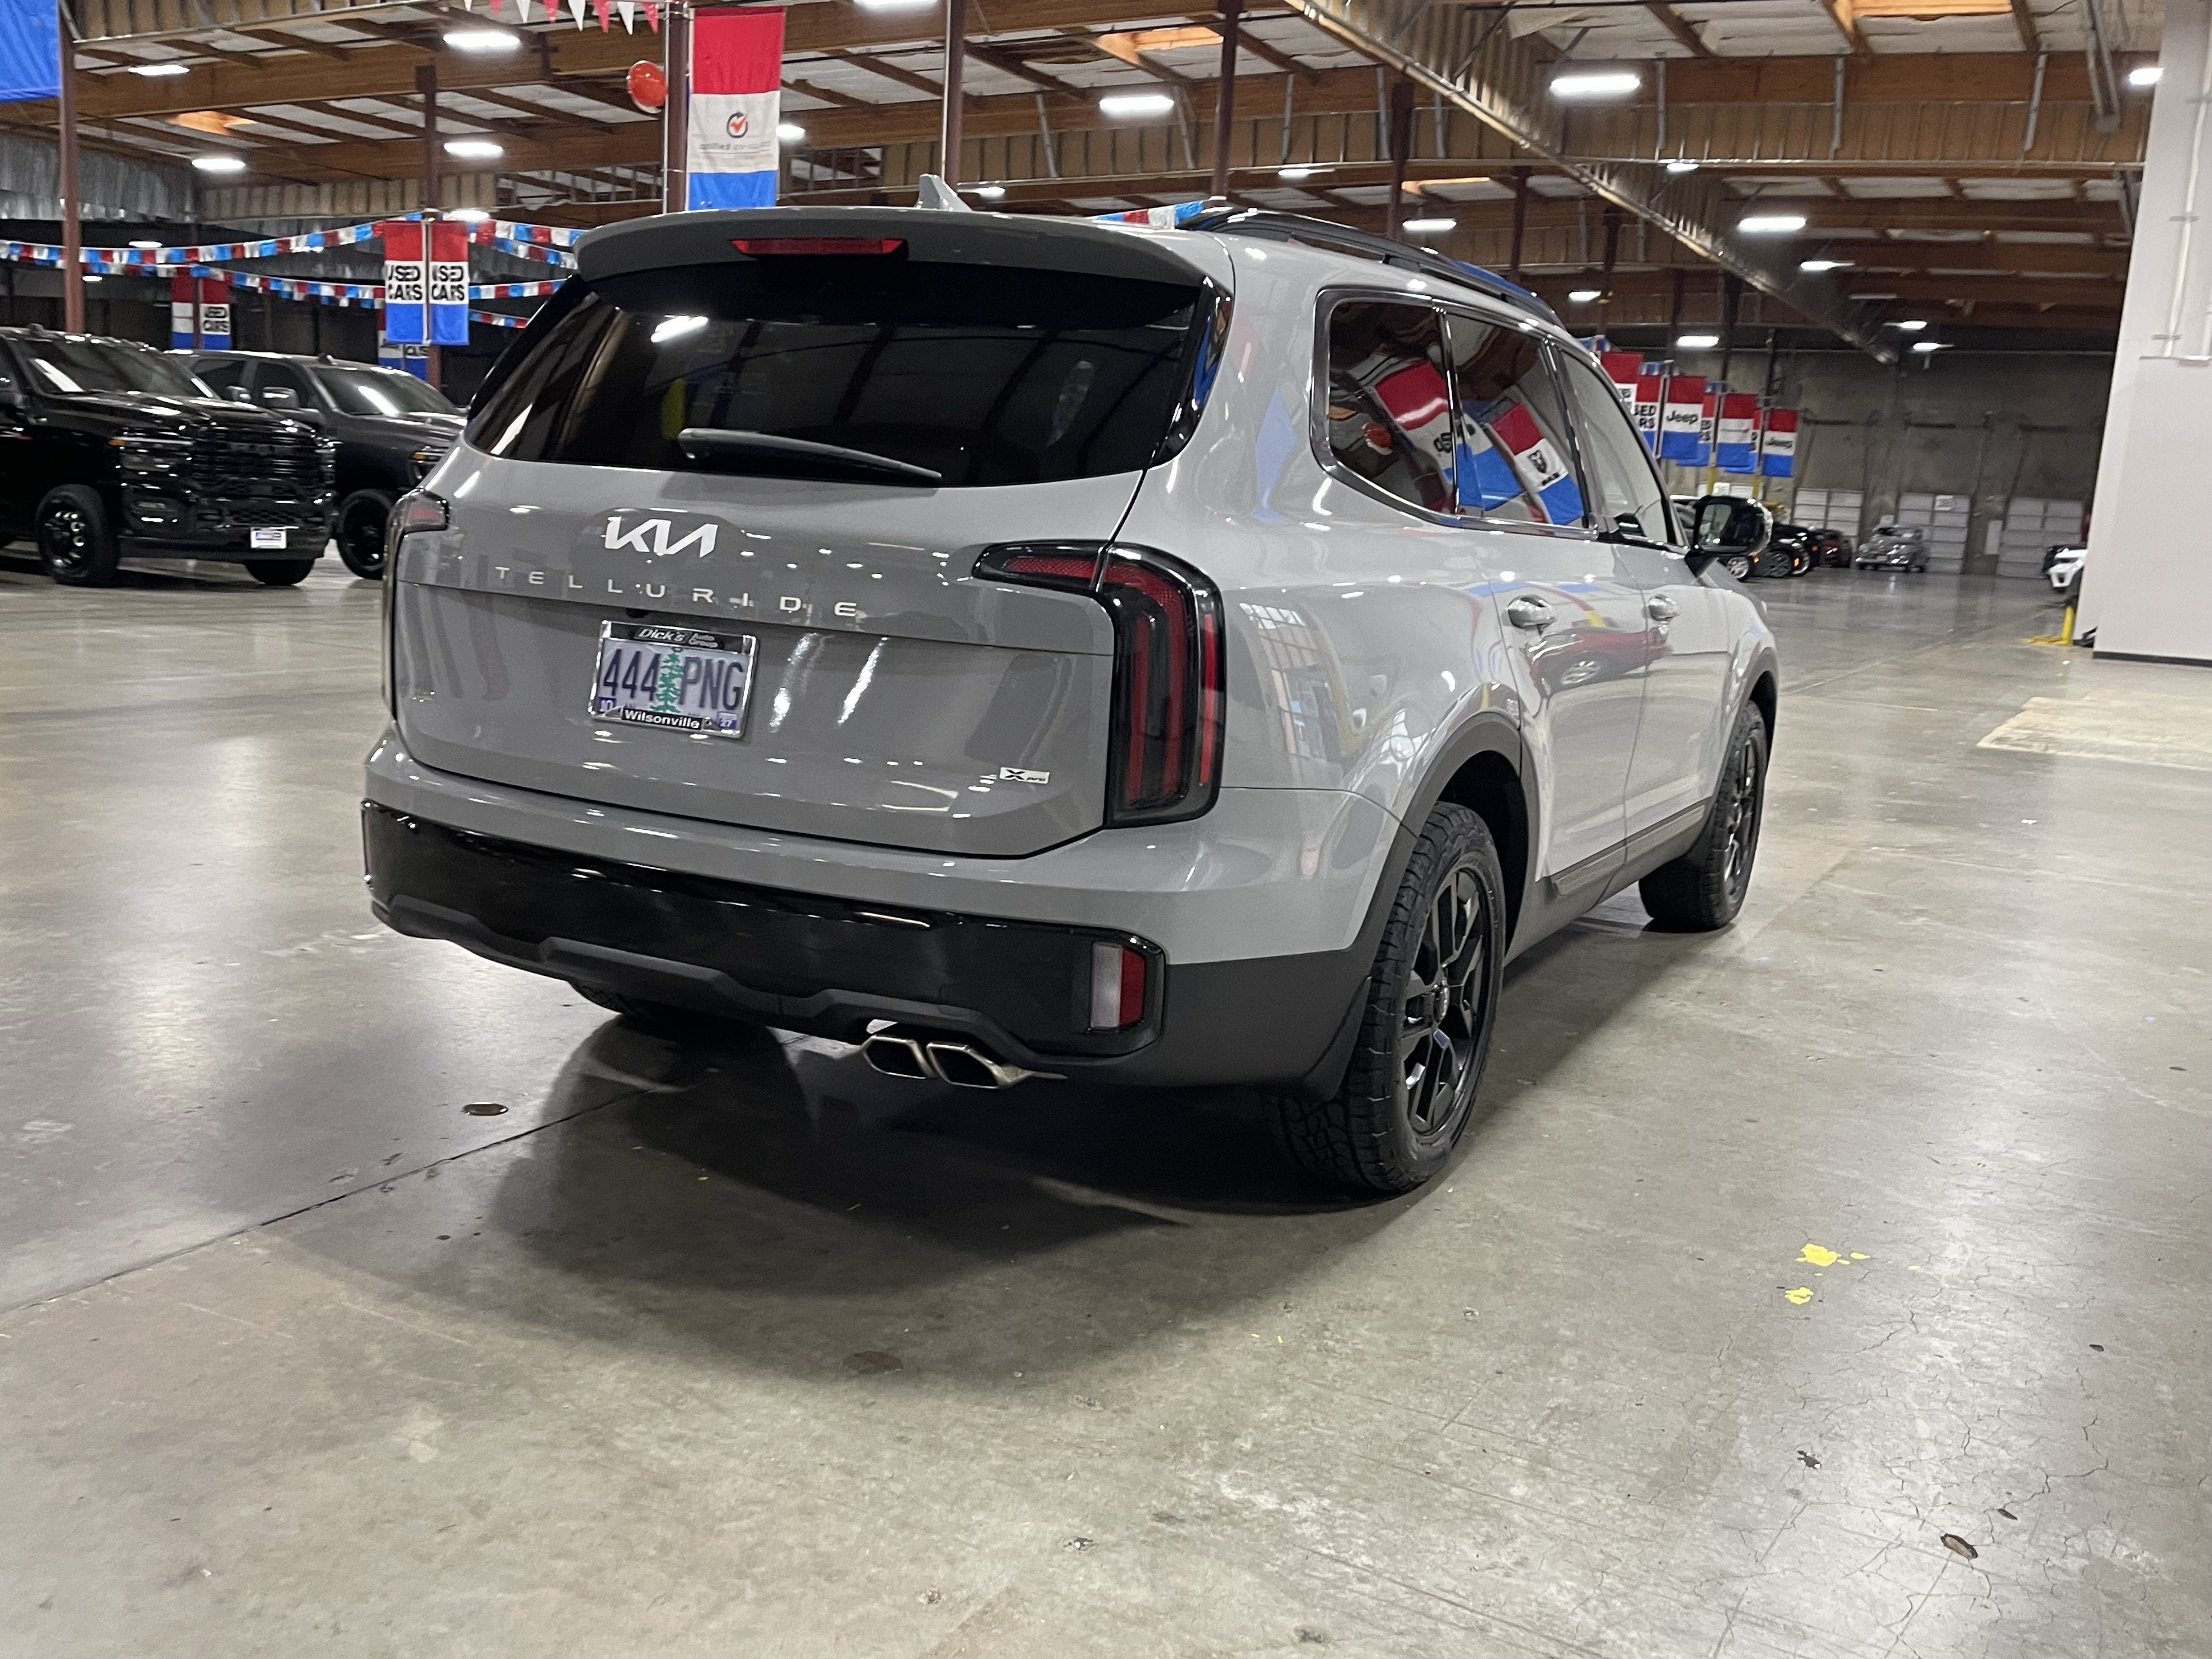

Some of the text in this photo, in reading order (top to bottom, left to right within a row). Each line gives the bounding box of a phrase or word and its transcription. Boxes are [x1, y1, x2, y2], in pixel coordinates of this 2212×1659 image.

[1666, 410, 1699, 425] Jeep
[605, 516, 719, 558] KIA
[495, 566, 857, 618] TELLURIDE
[639, 629, 685, 642] Dick's
[689, 638, 718, 648] Group
[692, 633, 715, 641] Auto
[603, 648, 744, 710] 444 PNG
[624, 709, 700, 729] Wilsonville
[720, 718, 732, 727] 27
